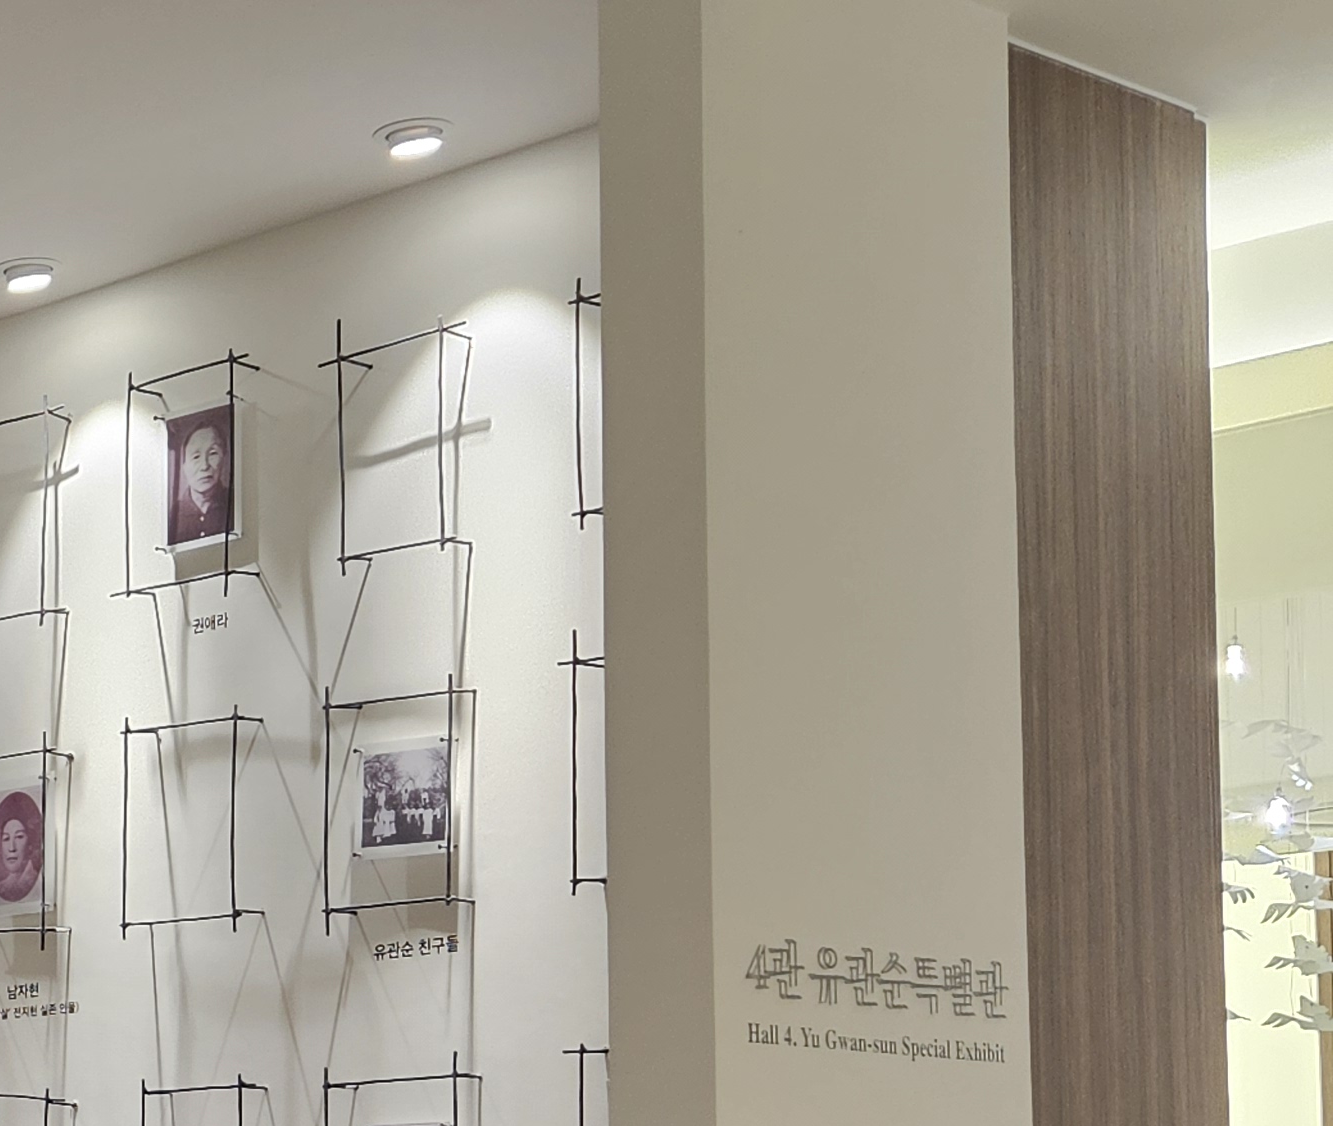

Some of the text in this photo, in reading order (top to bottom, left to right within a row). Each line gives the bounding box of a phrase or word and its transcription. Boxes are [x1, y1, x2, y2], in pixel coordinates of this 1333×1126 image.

[192, 611, 229, 635] 권애라
[373, 934, 459, 961] 유관순 친구들
[7, 982, 39, 1000] 남자현
[747, 1022, 1006, 1064] Hall 4. Yu Gwan-sun Special Exhibit
